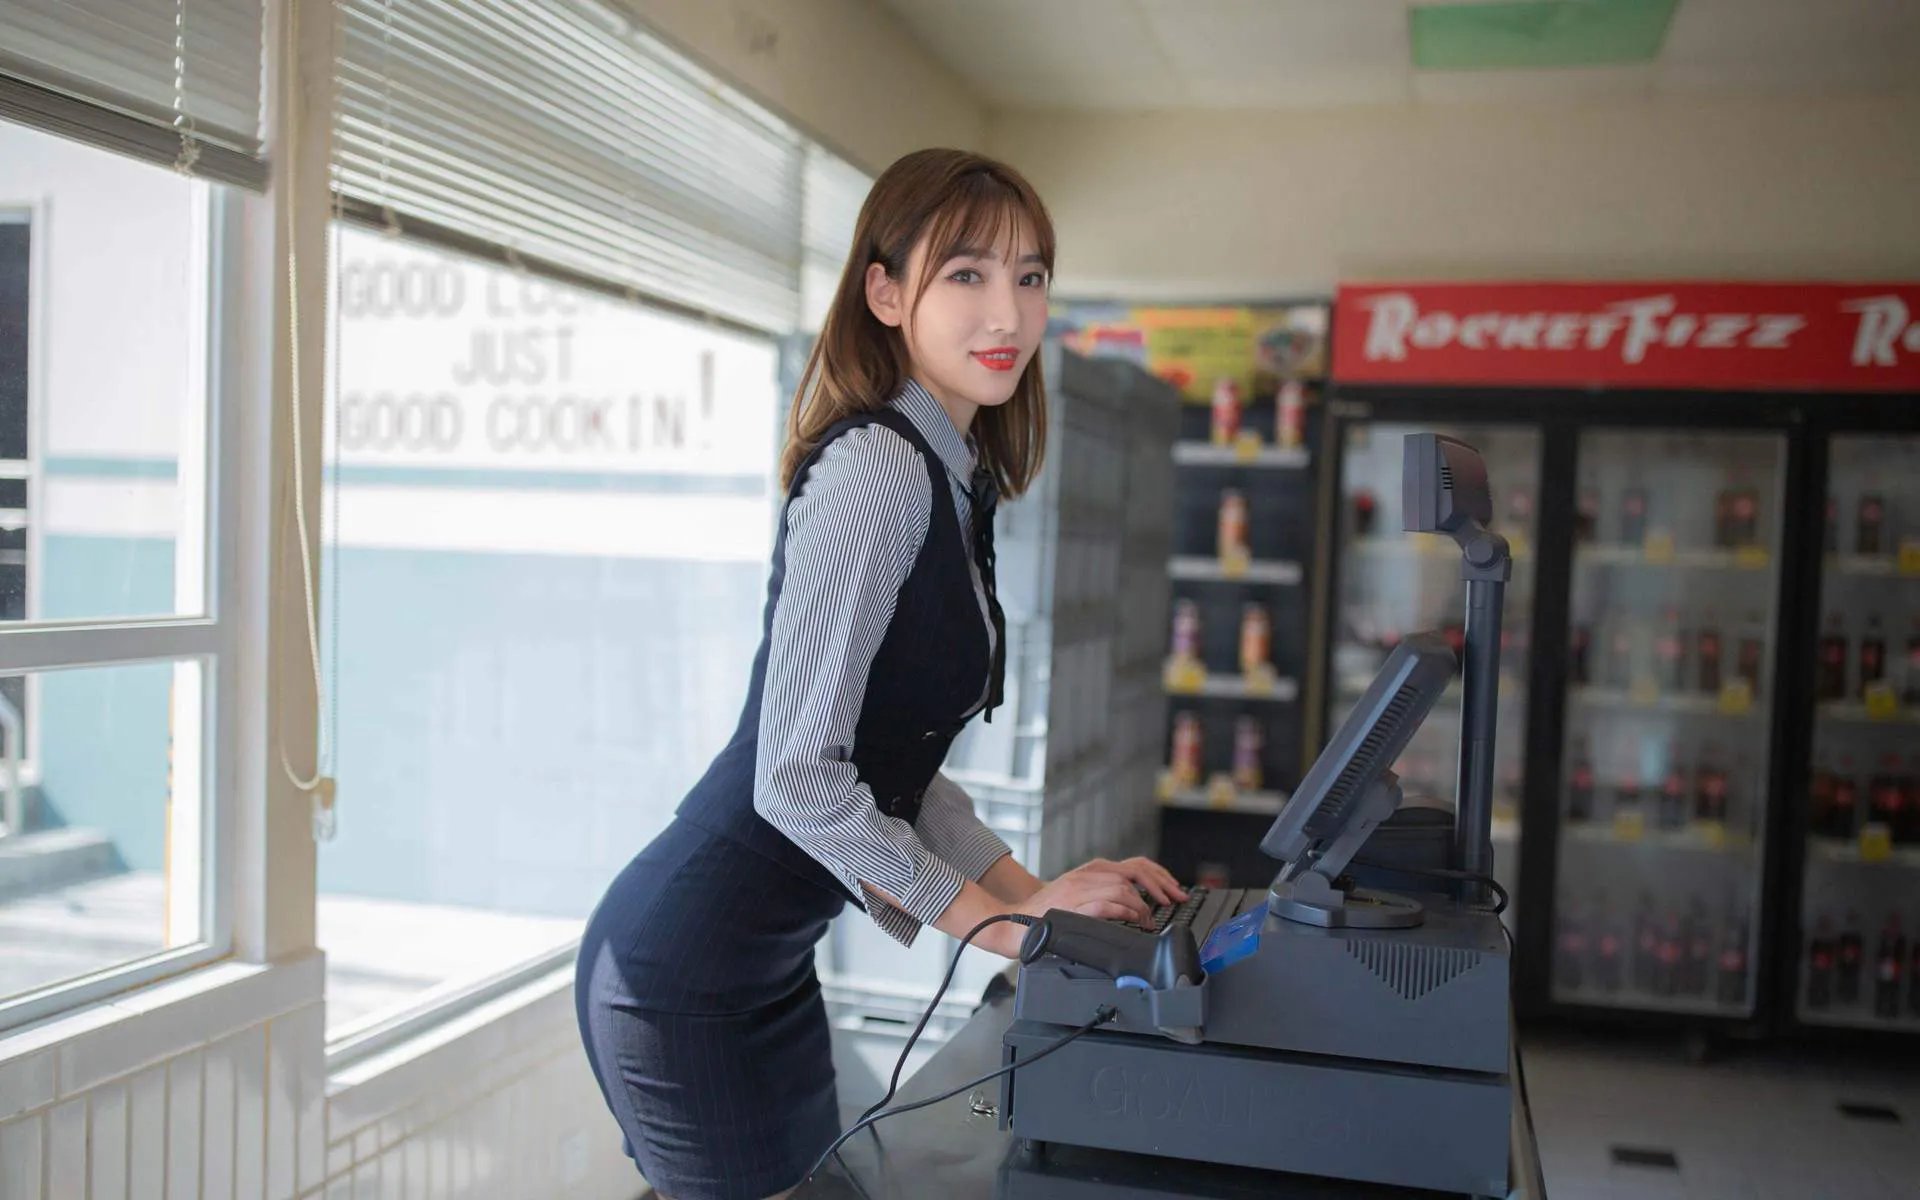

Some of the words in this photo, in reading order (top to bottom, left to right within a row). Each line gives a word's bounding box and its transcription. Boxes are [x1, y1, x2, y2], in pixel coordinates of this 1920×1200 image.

[342, 262, 466, 318] GOOD
[453, 325, 574, 386] JUST
[341, 393, 464, 452] GOOD
